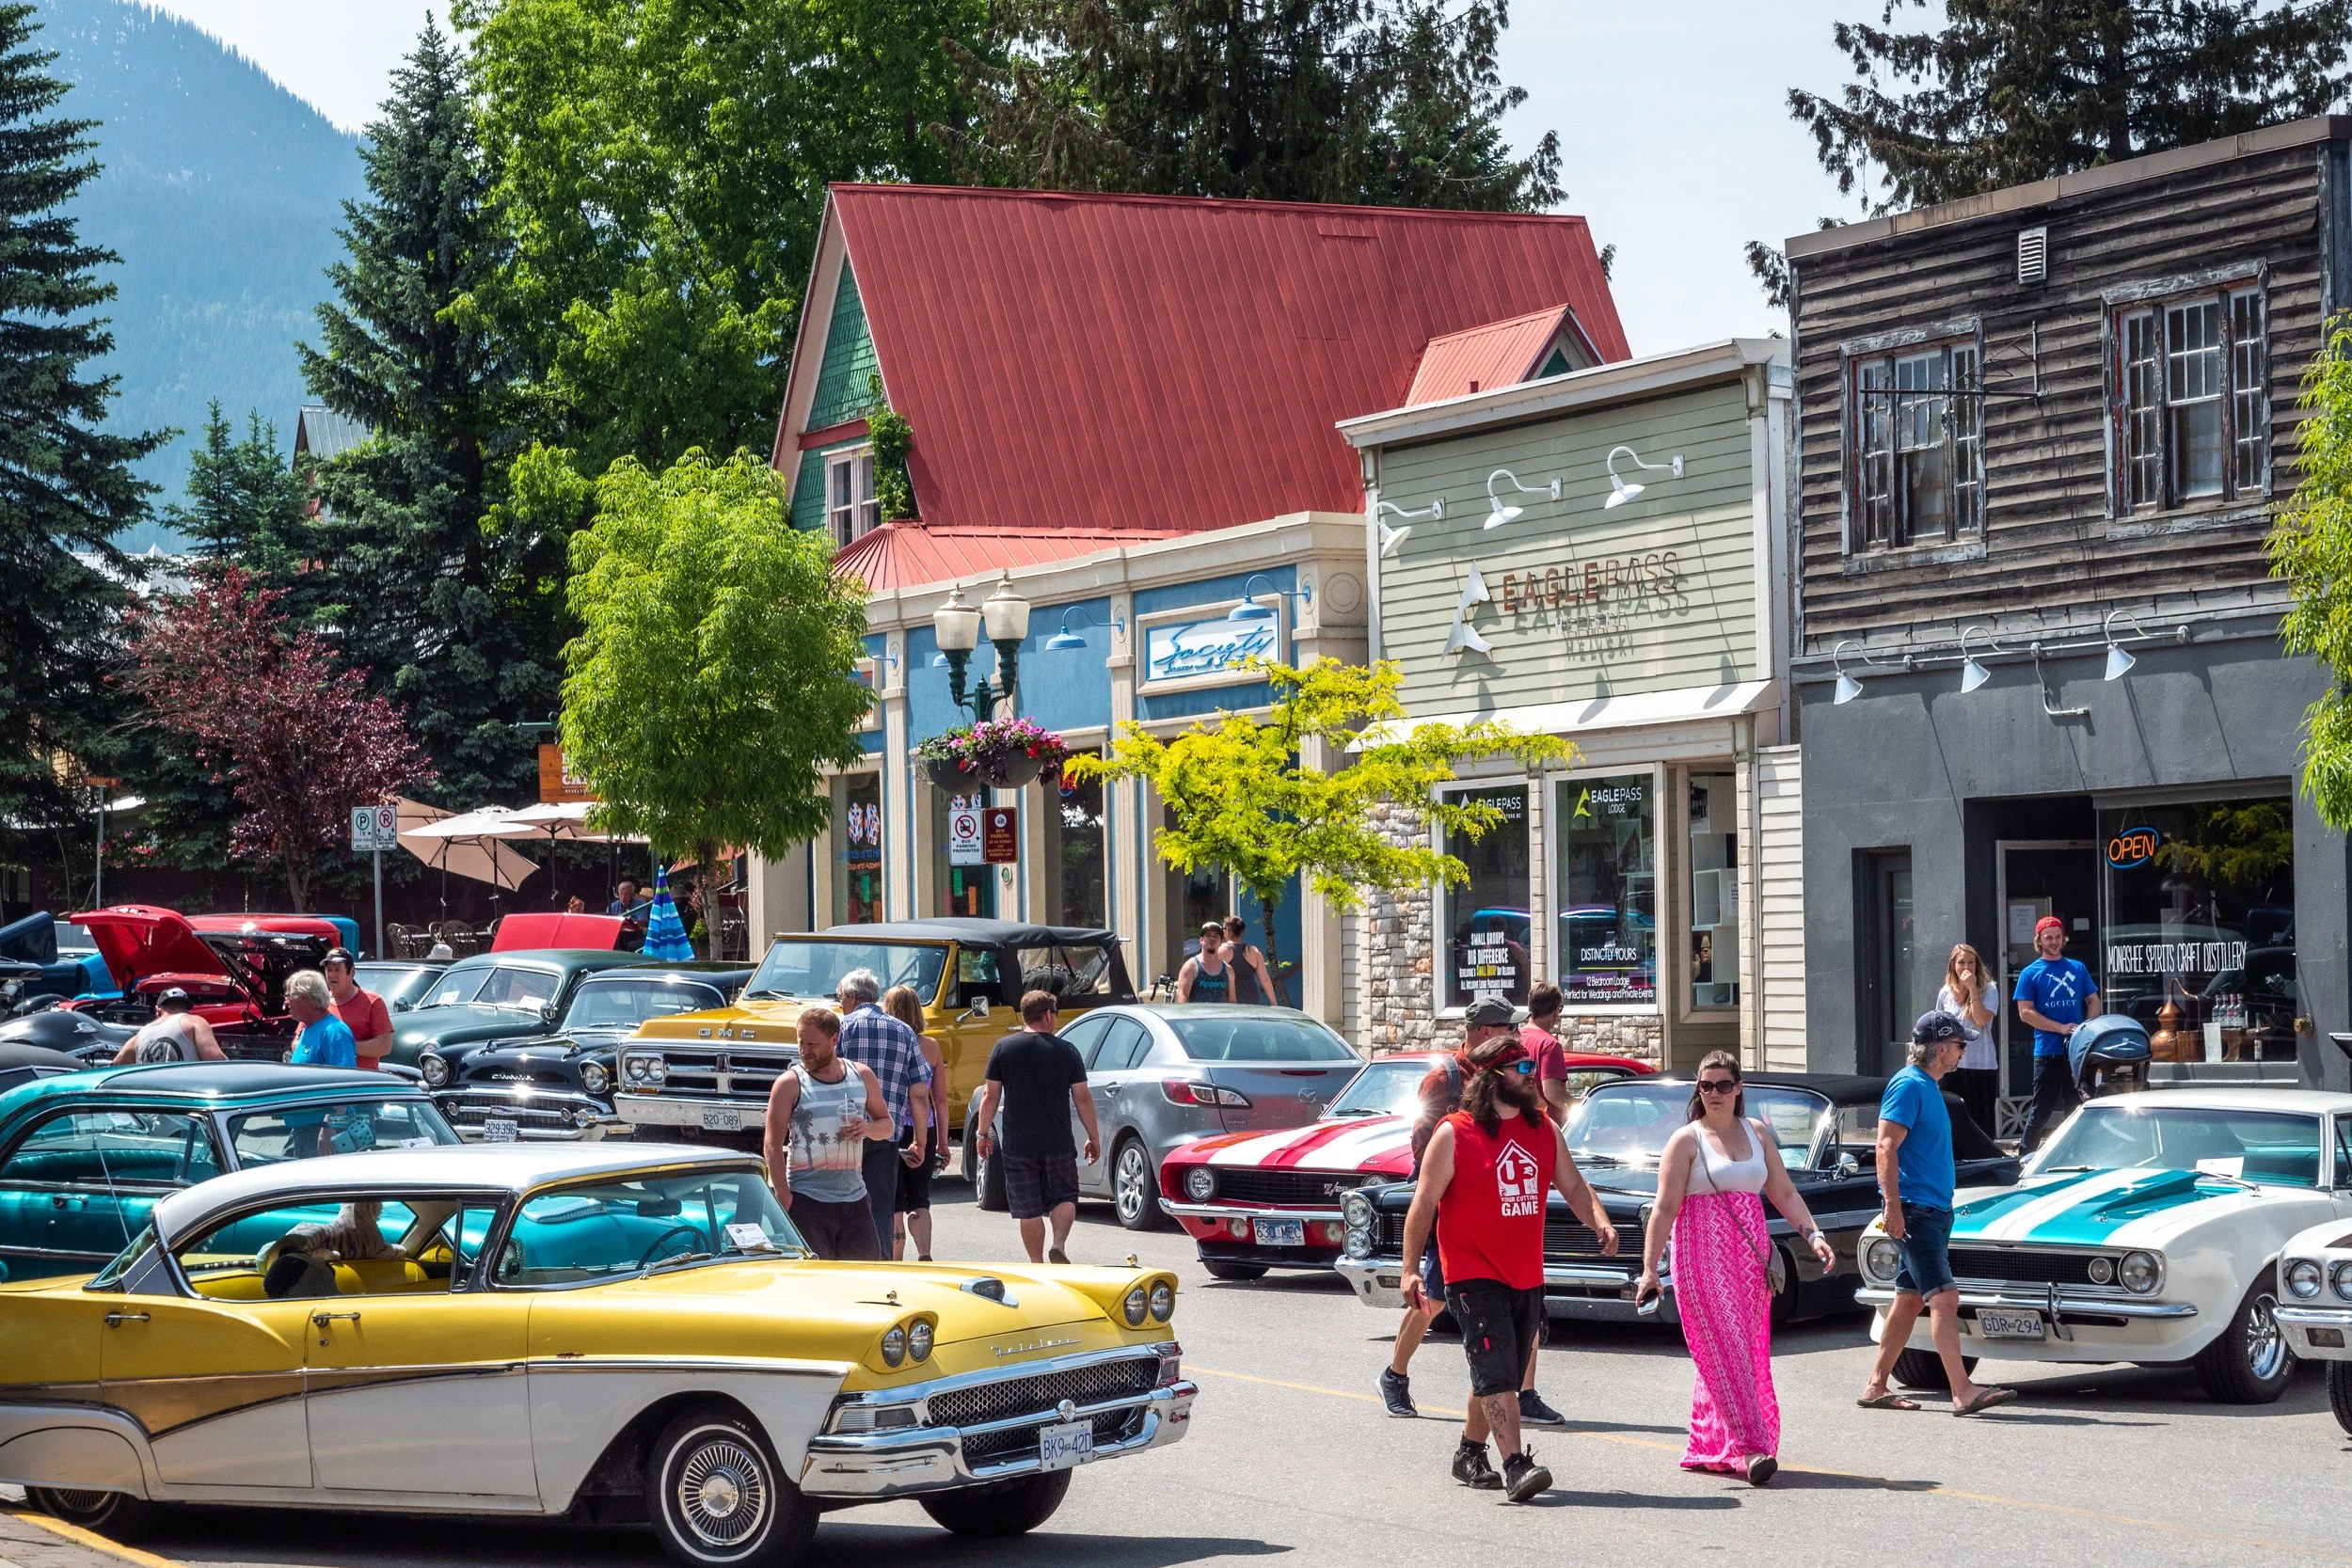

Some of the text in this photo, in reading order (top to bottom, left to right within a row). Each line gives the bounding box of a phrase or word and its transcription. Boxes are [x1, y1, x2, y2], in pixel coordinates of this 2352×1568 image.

[1608, 803, 1626, 815] LODGE
[2109, 834, 2155, 862] OPEN
[1470, 932, 1486, 946] SMALL
[1468, 947, 1509, 965] BIG DIFFERENCE
[2107, 941, 2248, 974] MONASHEE SPIRITS CRAFT DISTILLERY
[1592, 975, 1613, 986] Bedroom
[1613, 975, 1630, 989] Lodge
[1564, 989, 1581, 999] Perfect
[1588, 988, 1612, 1001] Weddings
[1612, 989, 1622, 998] and
[1622, 988, 1639, 998] Private
[1639, 987, 1653, 998] Events
[699, 1028, 755, 1038] GMC
[1501, 1201, 1539, 1217] GAME
[1983, 1317, 2042, 1334] GDR 294
[1044, 1433, 1092, 1460] BK9 42D
